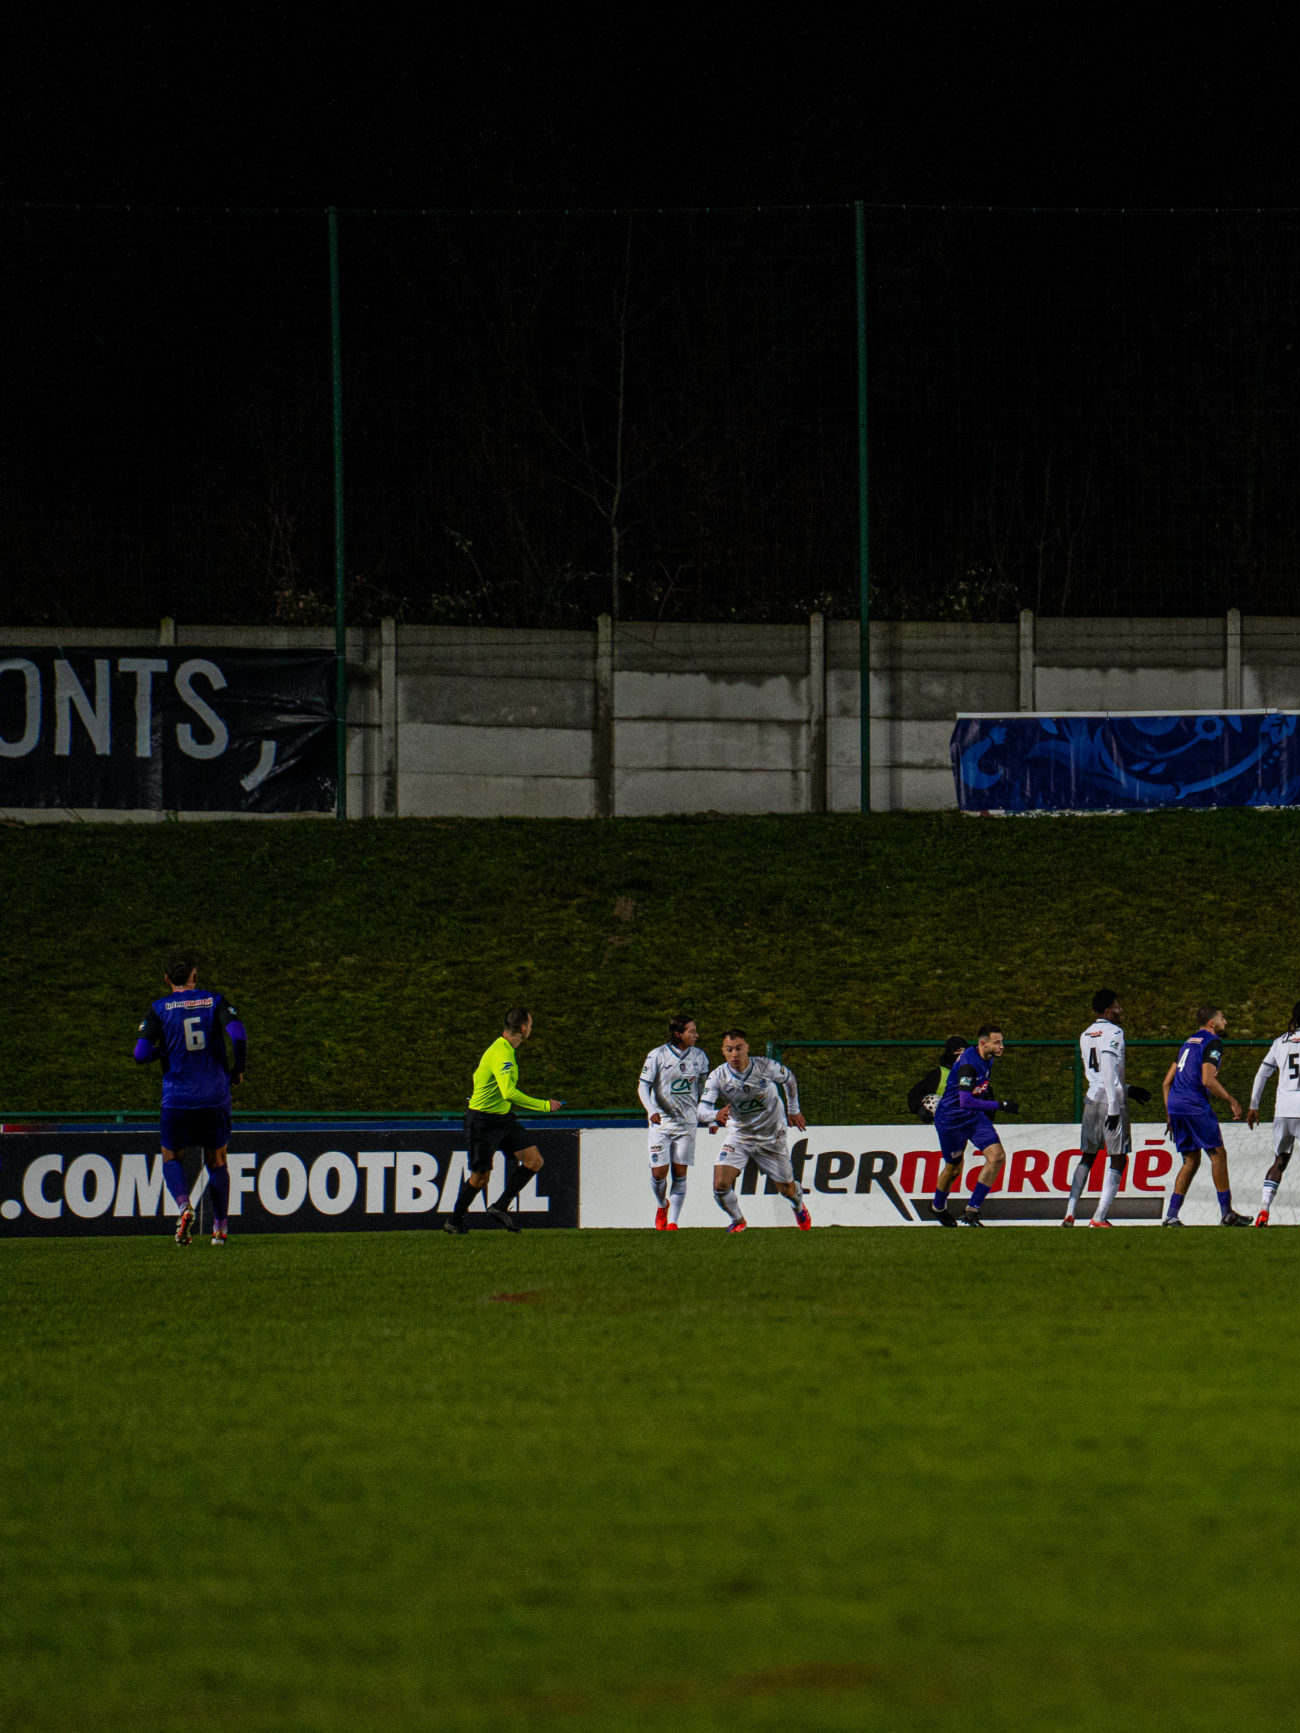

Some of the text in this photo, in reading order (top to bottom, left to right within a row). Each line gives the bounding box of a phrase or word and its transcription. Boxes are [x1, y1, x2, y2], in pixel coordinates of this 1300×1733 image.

[183, 1015, 207, 1052] 6
[1089, 1047, 1100, 1073] 4
[1177, 1047, 1190, 1072] 4
[1289, 1053, 1300, 1079] 5
